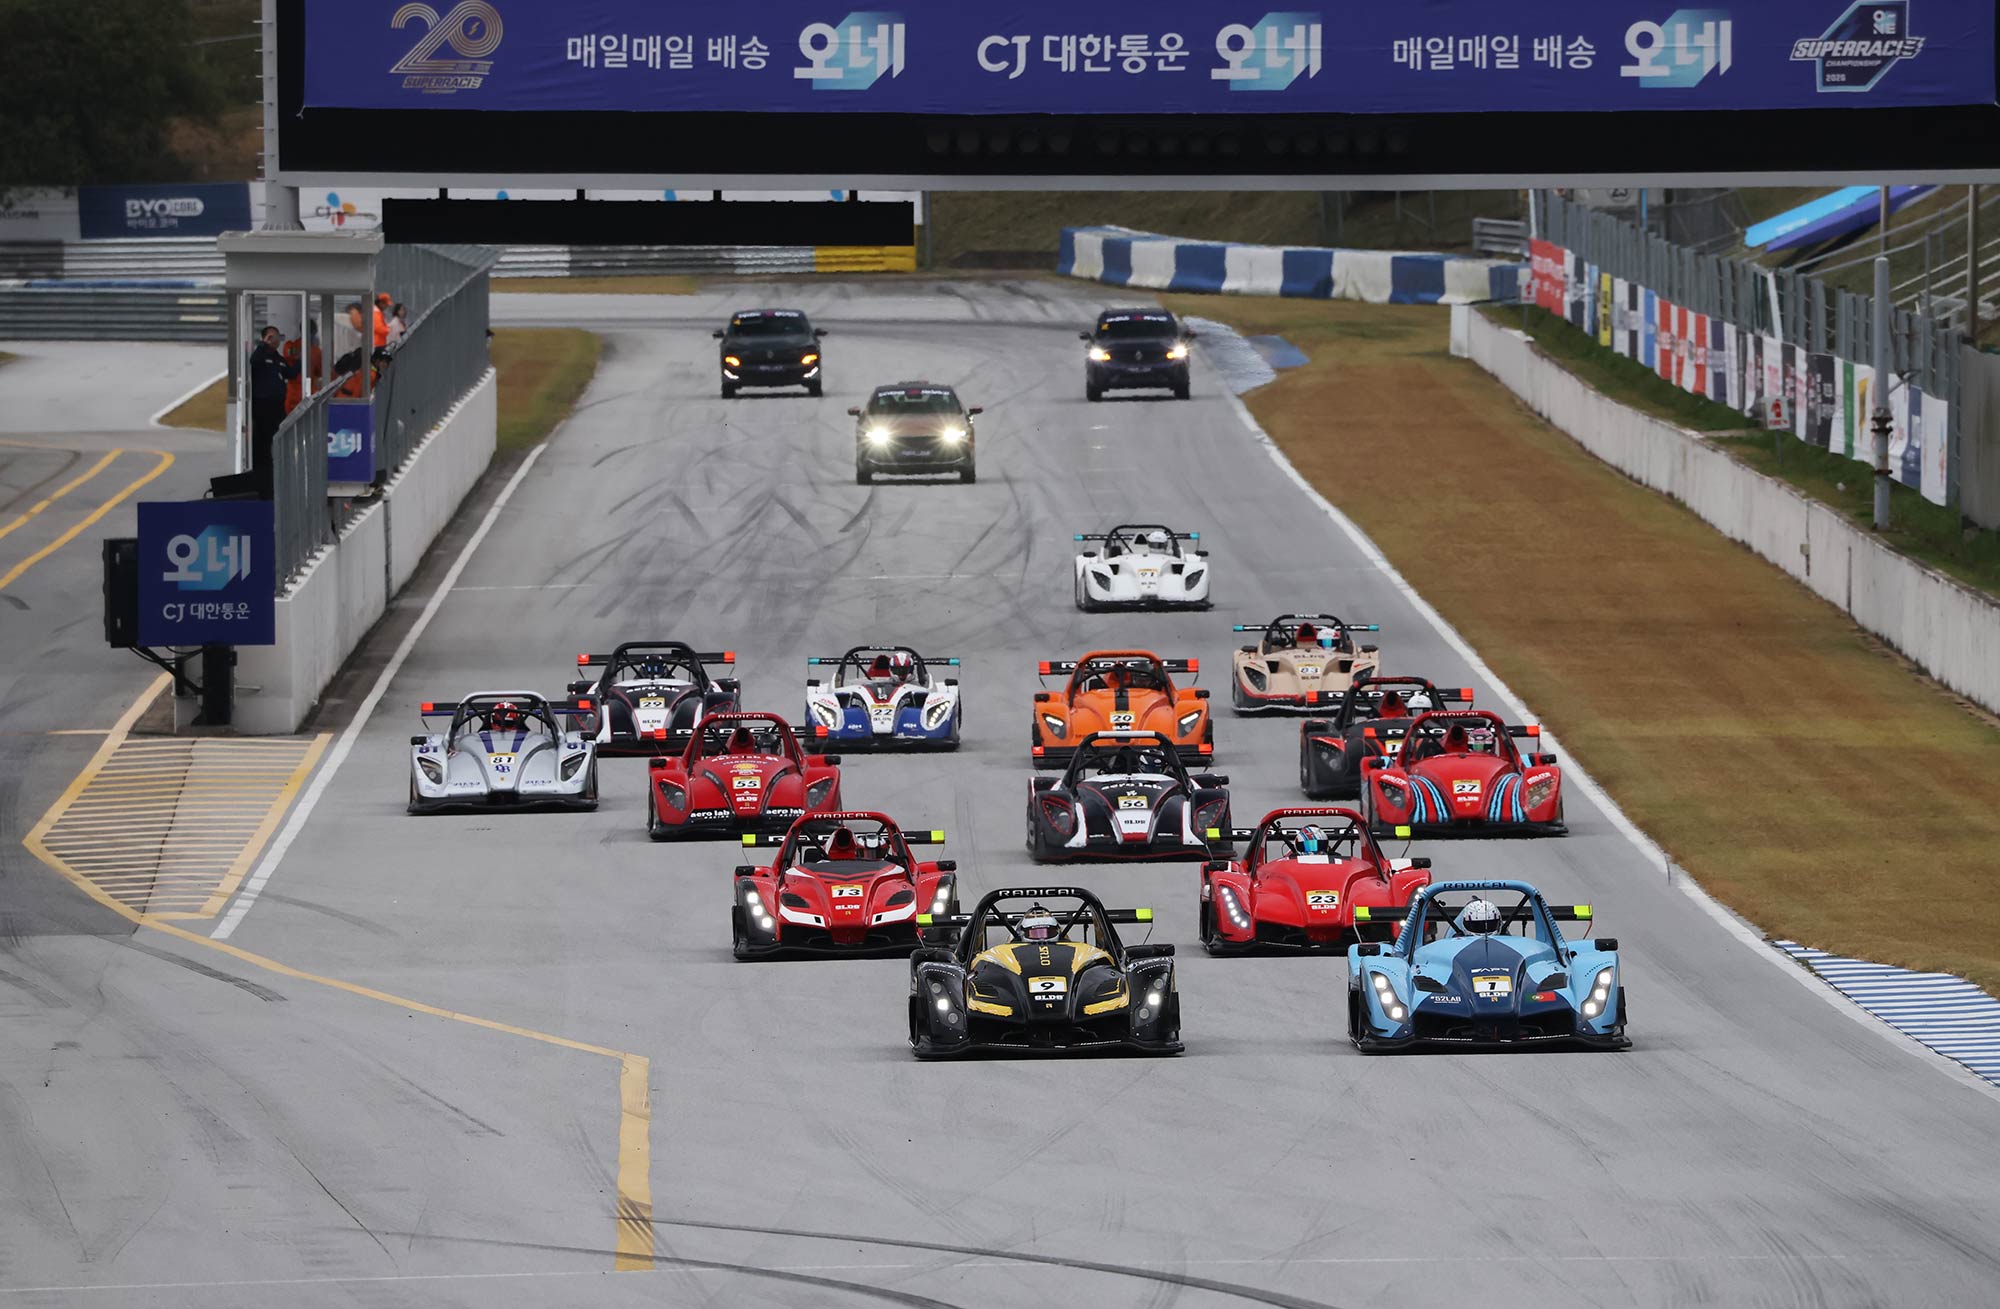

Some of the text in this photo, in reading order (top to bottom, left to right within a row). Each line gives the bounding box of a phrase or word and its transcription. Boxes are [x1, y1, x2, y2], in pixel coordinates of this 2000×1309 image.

[567, 34, 770, 70] 매일매일 배송
[793, 22, 906, 80] 오네
[977, 33, 1190, 80] CJ 대한통운
[1211, 23, 1322, 80] 오네
[1393, 35, 1597, 71] 매일매일 배송
[1620, 20, 1732, 77] 오네
[1794, 40, 1917, 58] SUPERRACE
[126, 200, 171, 218] BYO
[163, 534, 251, 582] 오네
[163, 602, 251, 623] CJ 대한통운
[1113, 714, 1132, 722] 20
[492, 756, 513, 764] 81
[1310, 895, 1336, 903] 23
[1040, 982, 1055, 990] 9
[1488, 982, 1496, 991] 1
